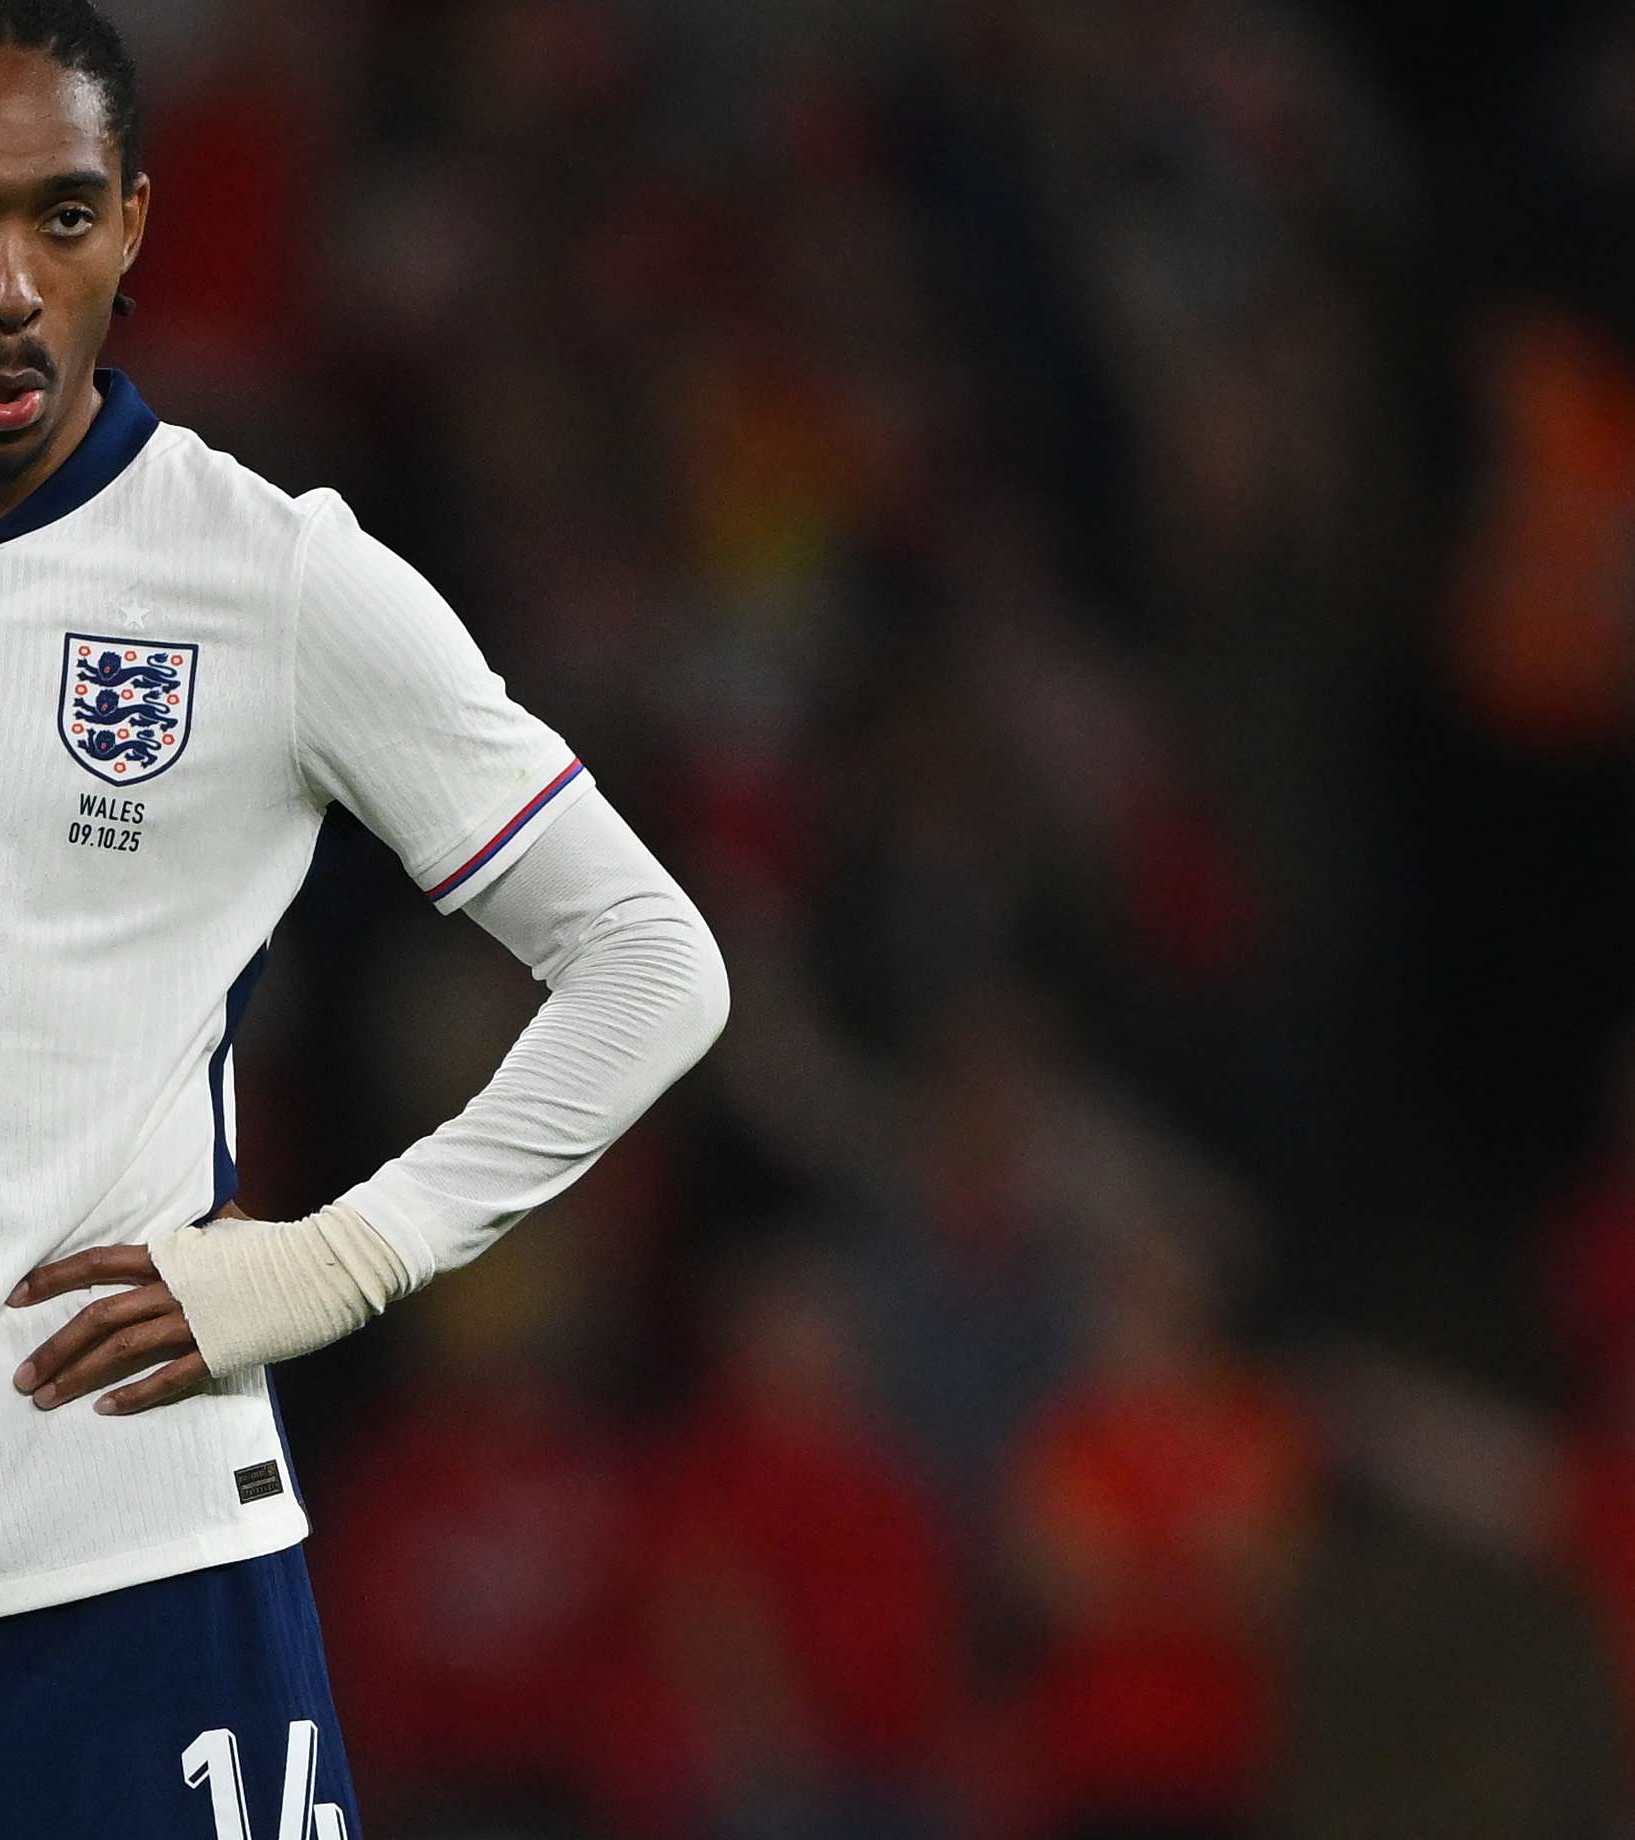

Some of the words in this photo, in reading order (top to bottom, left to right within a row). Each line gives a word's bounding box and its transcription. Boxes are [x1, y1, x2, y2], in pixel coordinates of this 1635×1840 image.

[79, 793, 145, 824] WALES
[68, 822, 142, 852] 09.10.25
[181, 1719, 349, 1840] 14
